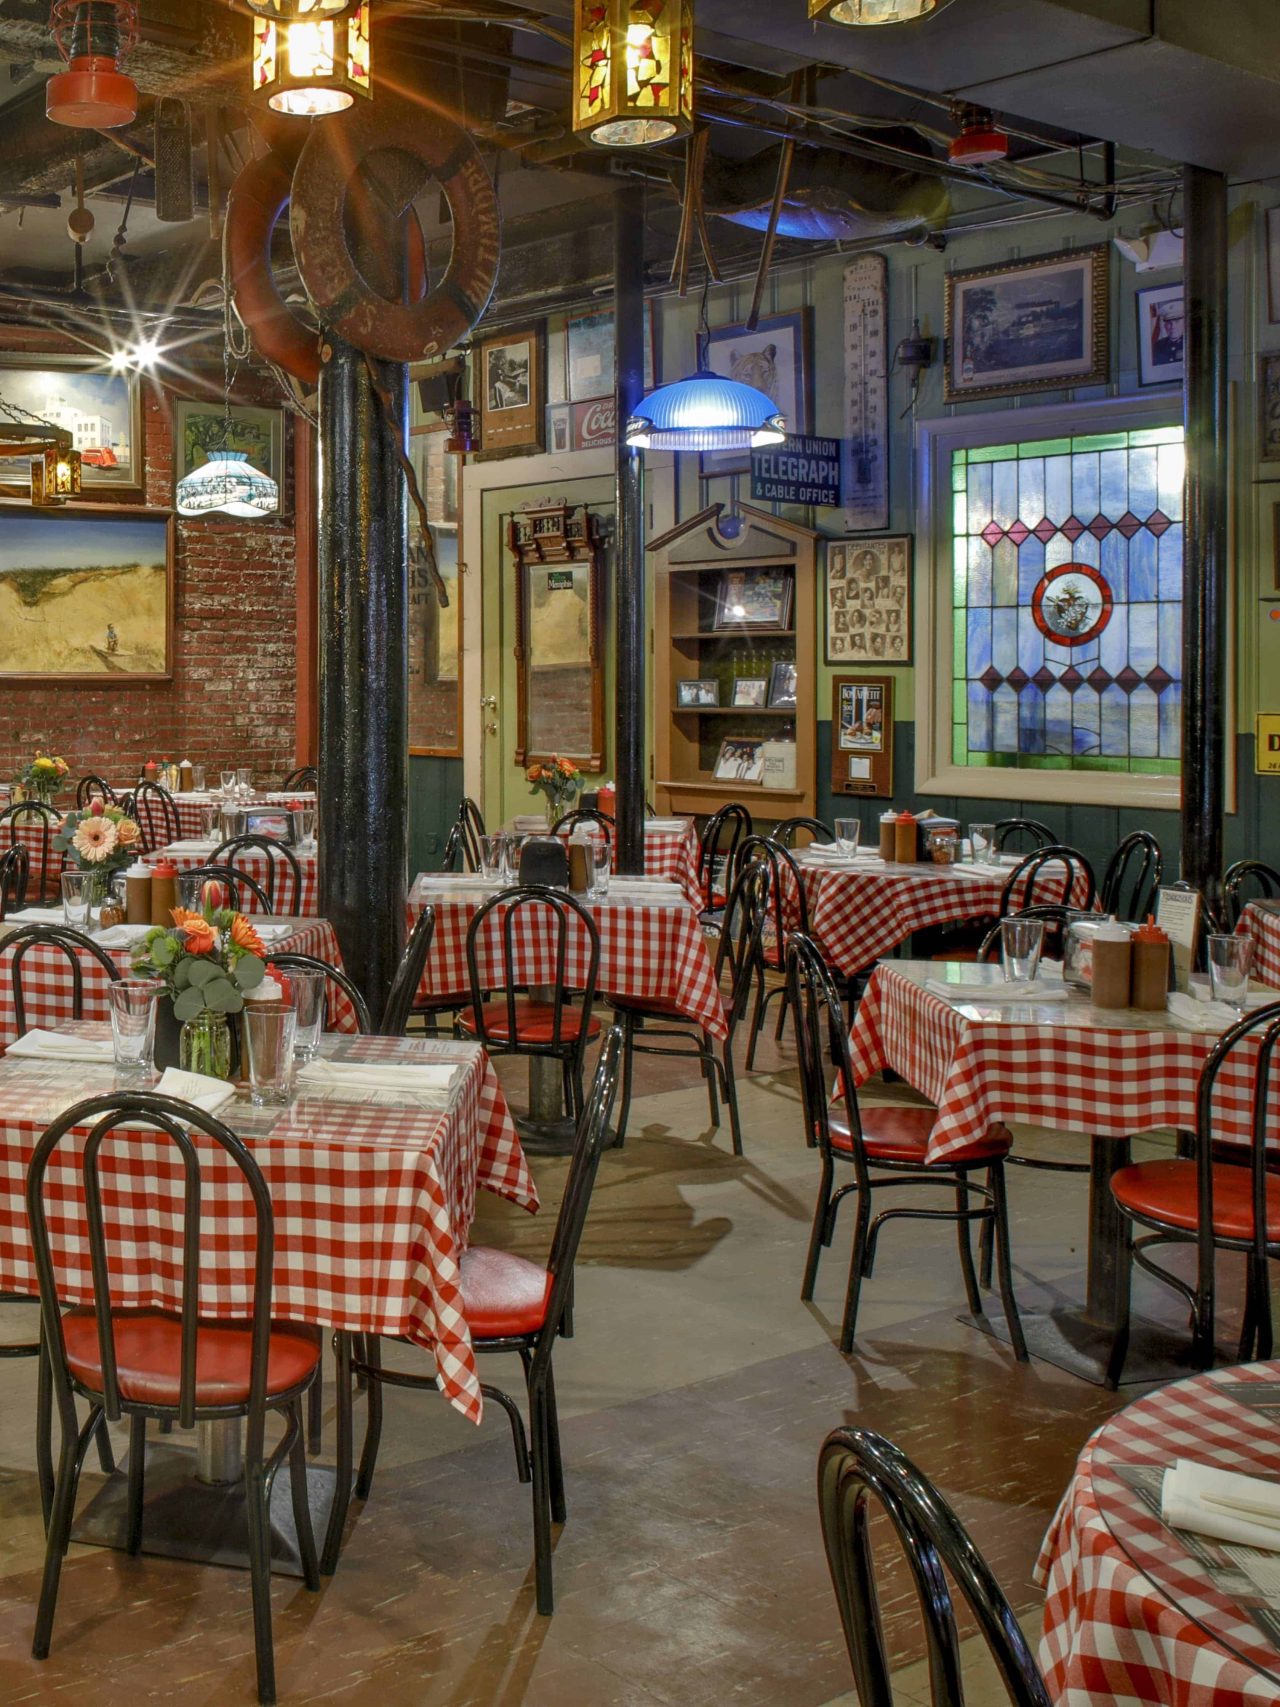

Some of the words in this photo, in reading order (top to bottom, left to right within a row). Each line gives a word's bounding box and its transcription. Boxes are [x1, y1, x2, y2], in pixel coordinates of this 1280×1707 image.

[805, 439, 836, 457] UNION
[752, 453, 839, 485] TELEGRAPH
[756, 482, 762, 496] &
[765, 483, 795, 499] CABLE
[799, 487, 835, 503] OFFICE
